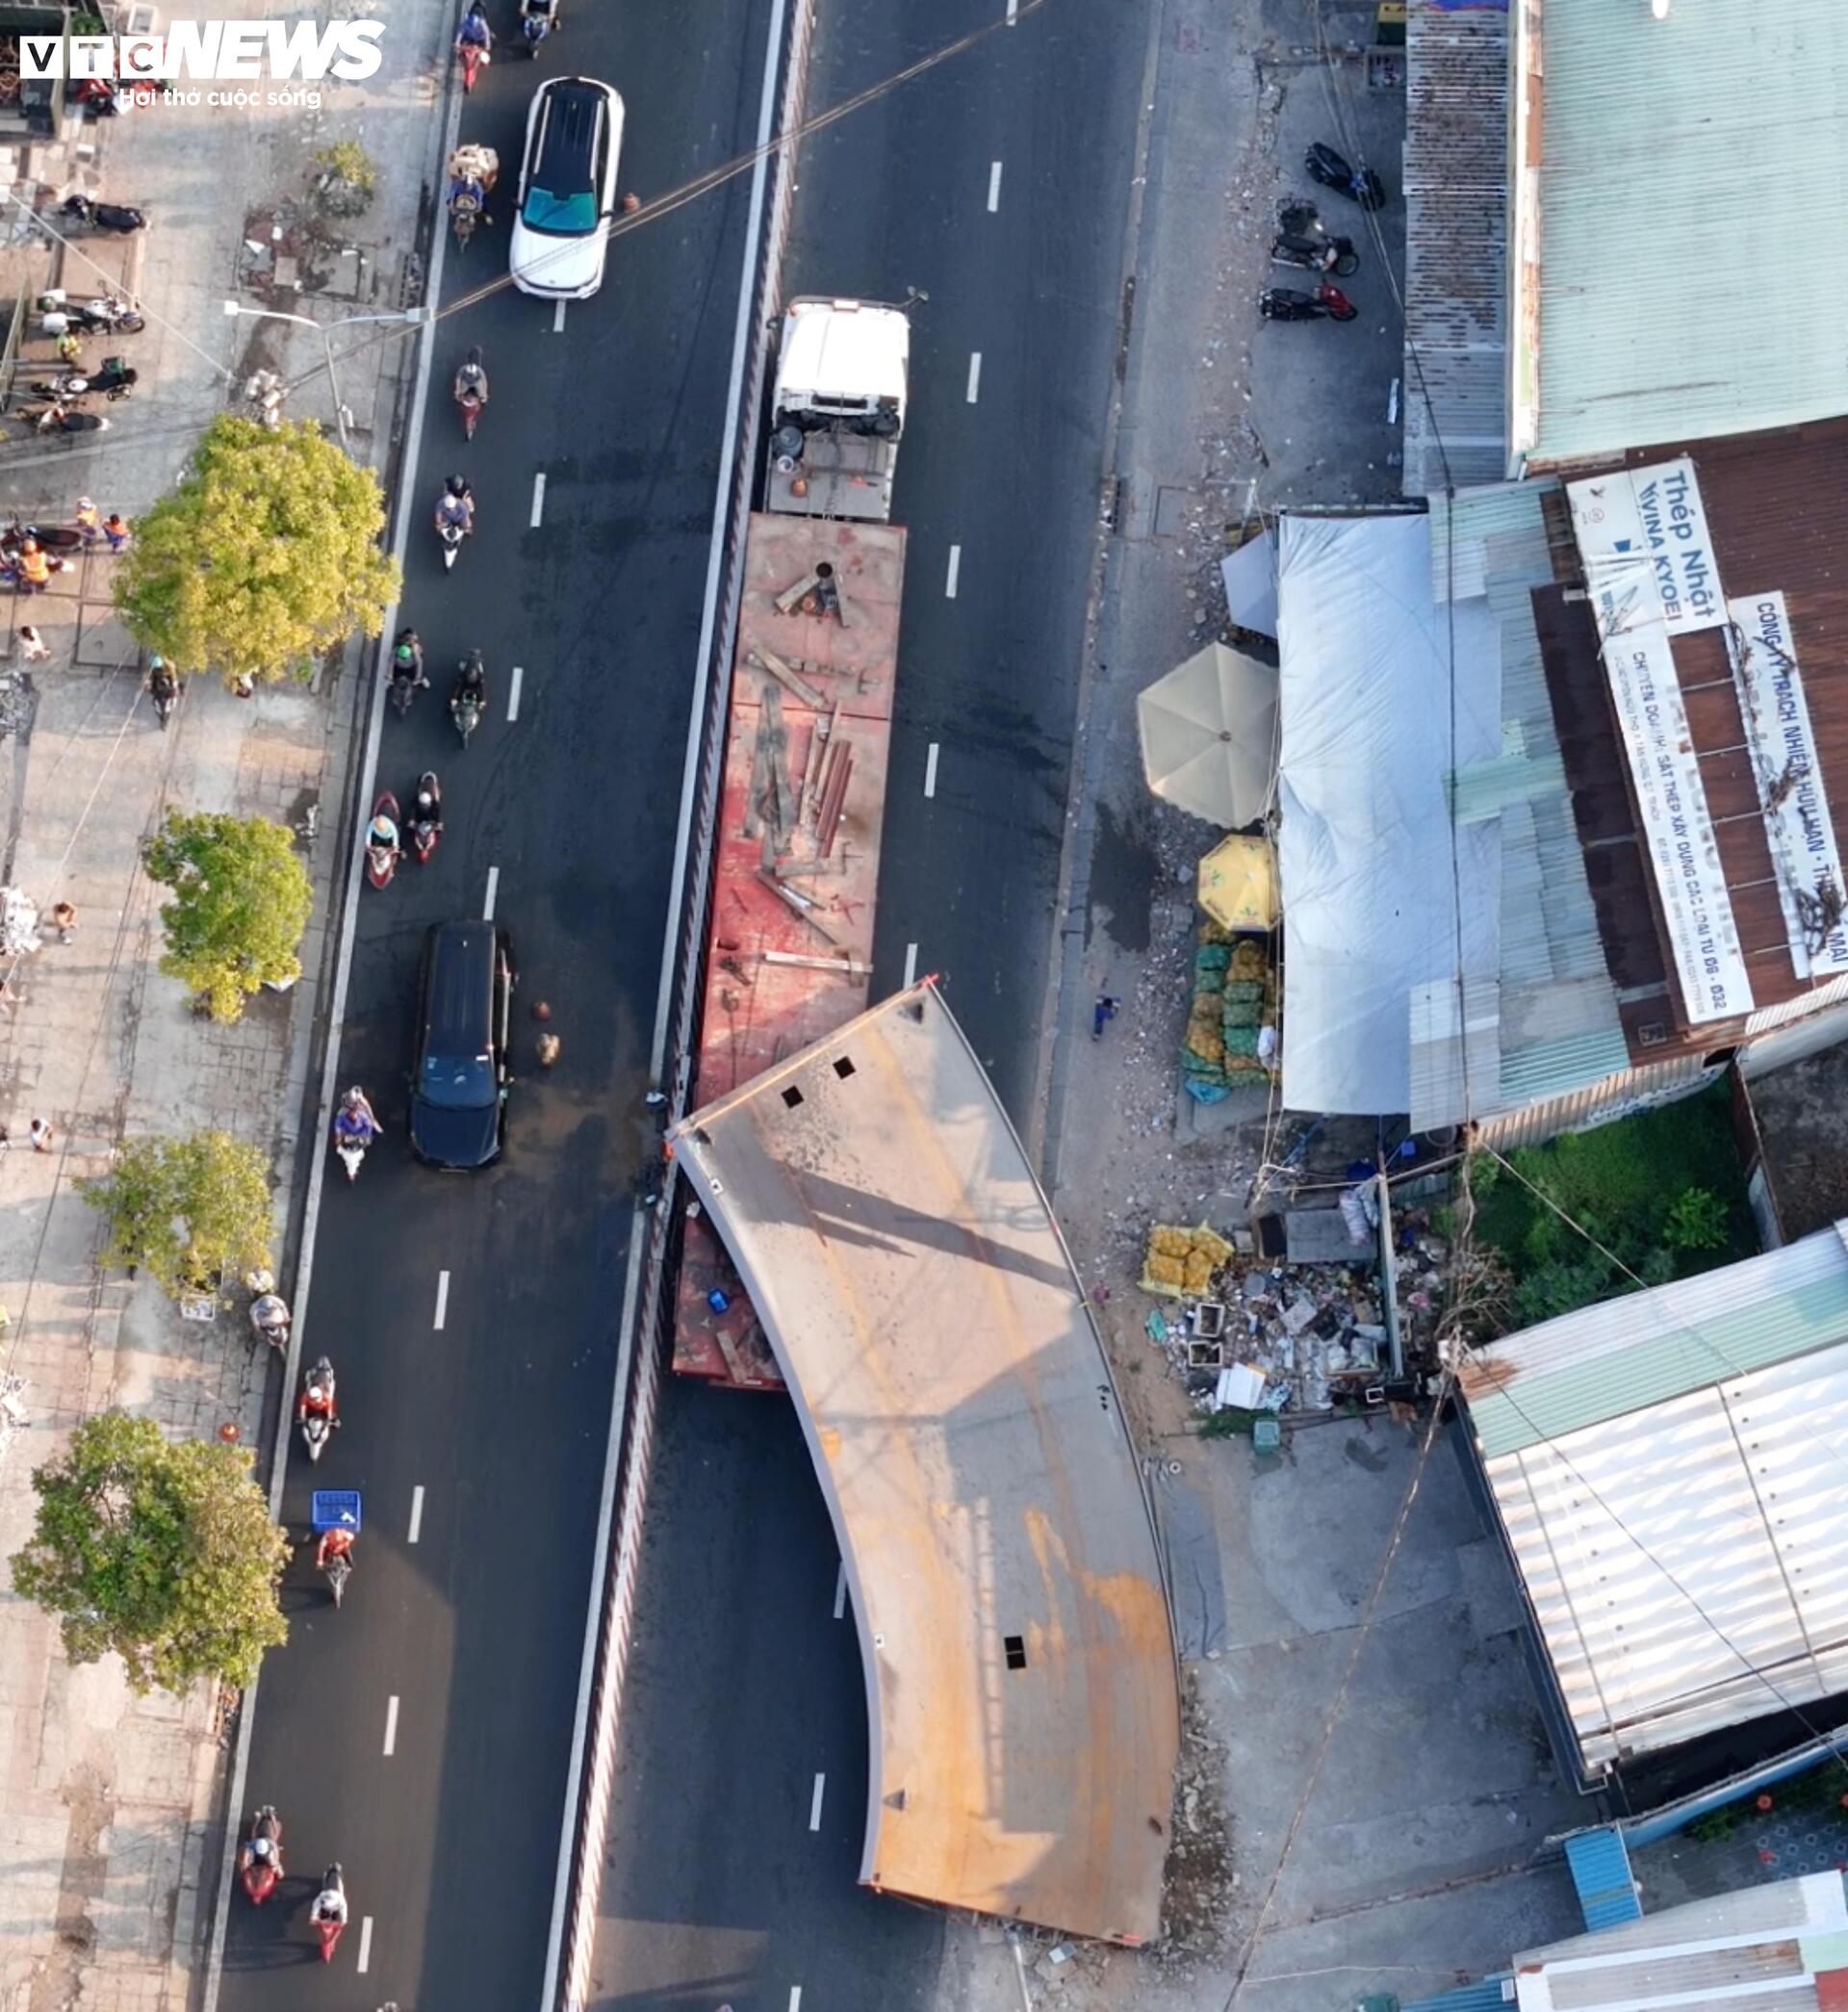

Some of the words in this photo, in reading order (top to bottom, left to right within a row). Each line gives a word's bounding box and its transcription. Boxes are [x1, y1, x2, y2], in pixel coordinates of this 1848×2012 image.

[1662, 470, 1696, 541] Thép
[1681, 549, 1716, 620] Nhật
[1654, 555, 1681, 621] KYOEI
[1757, 601, 1783, 646] CÔNG
